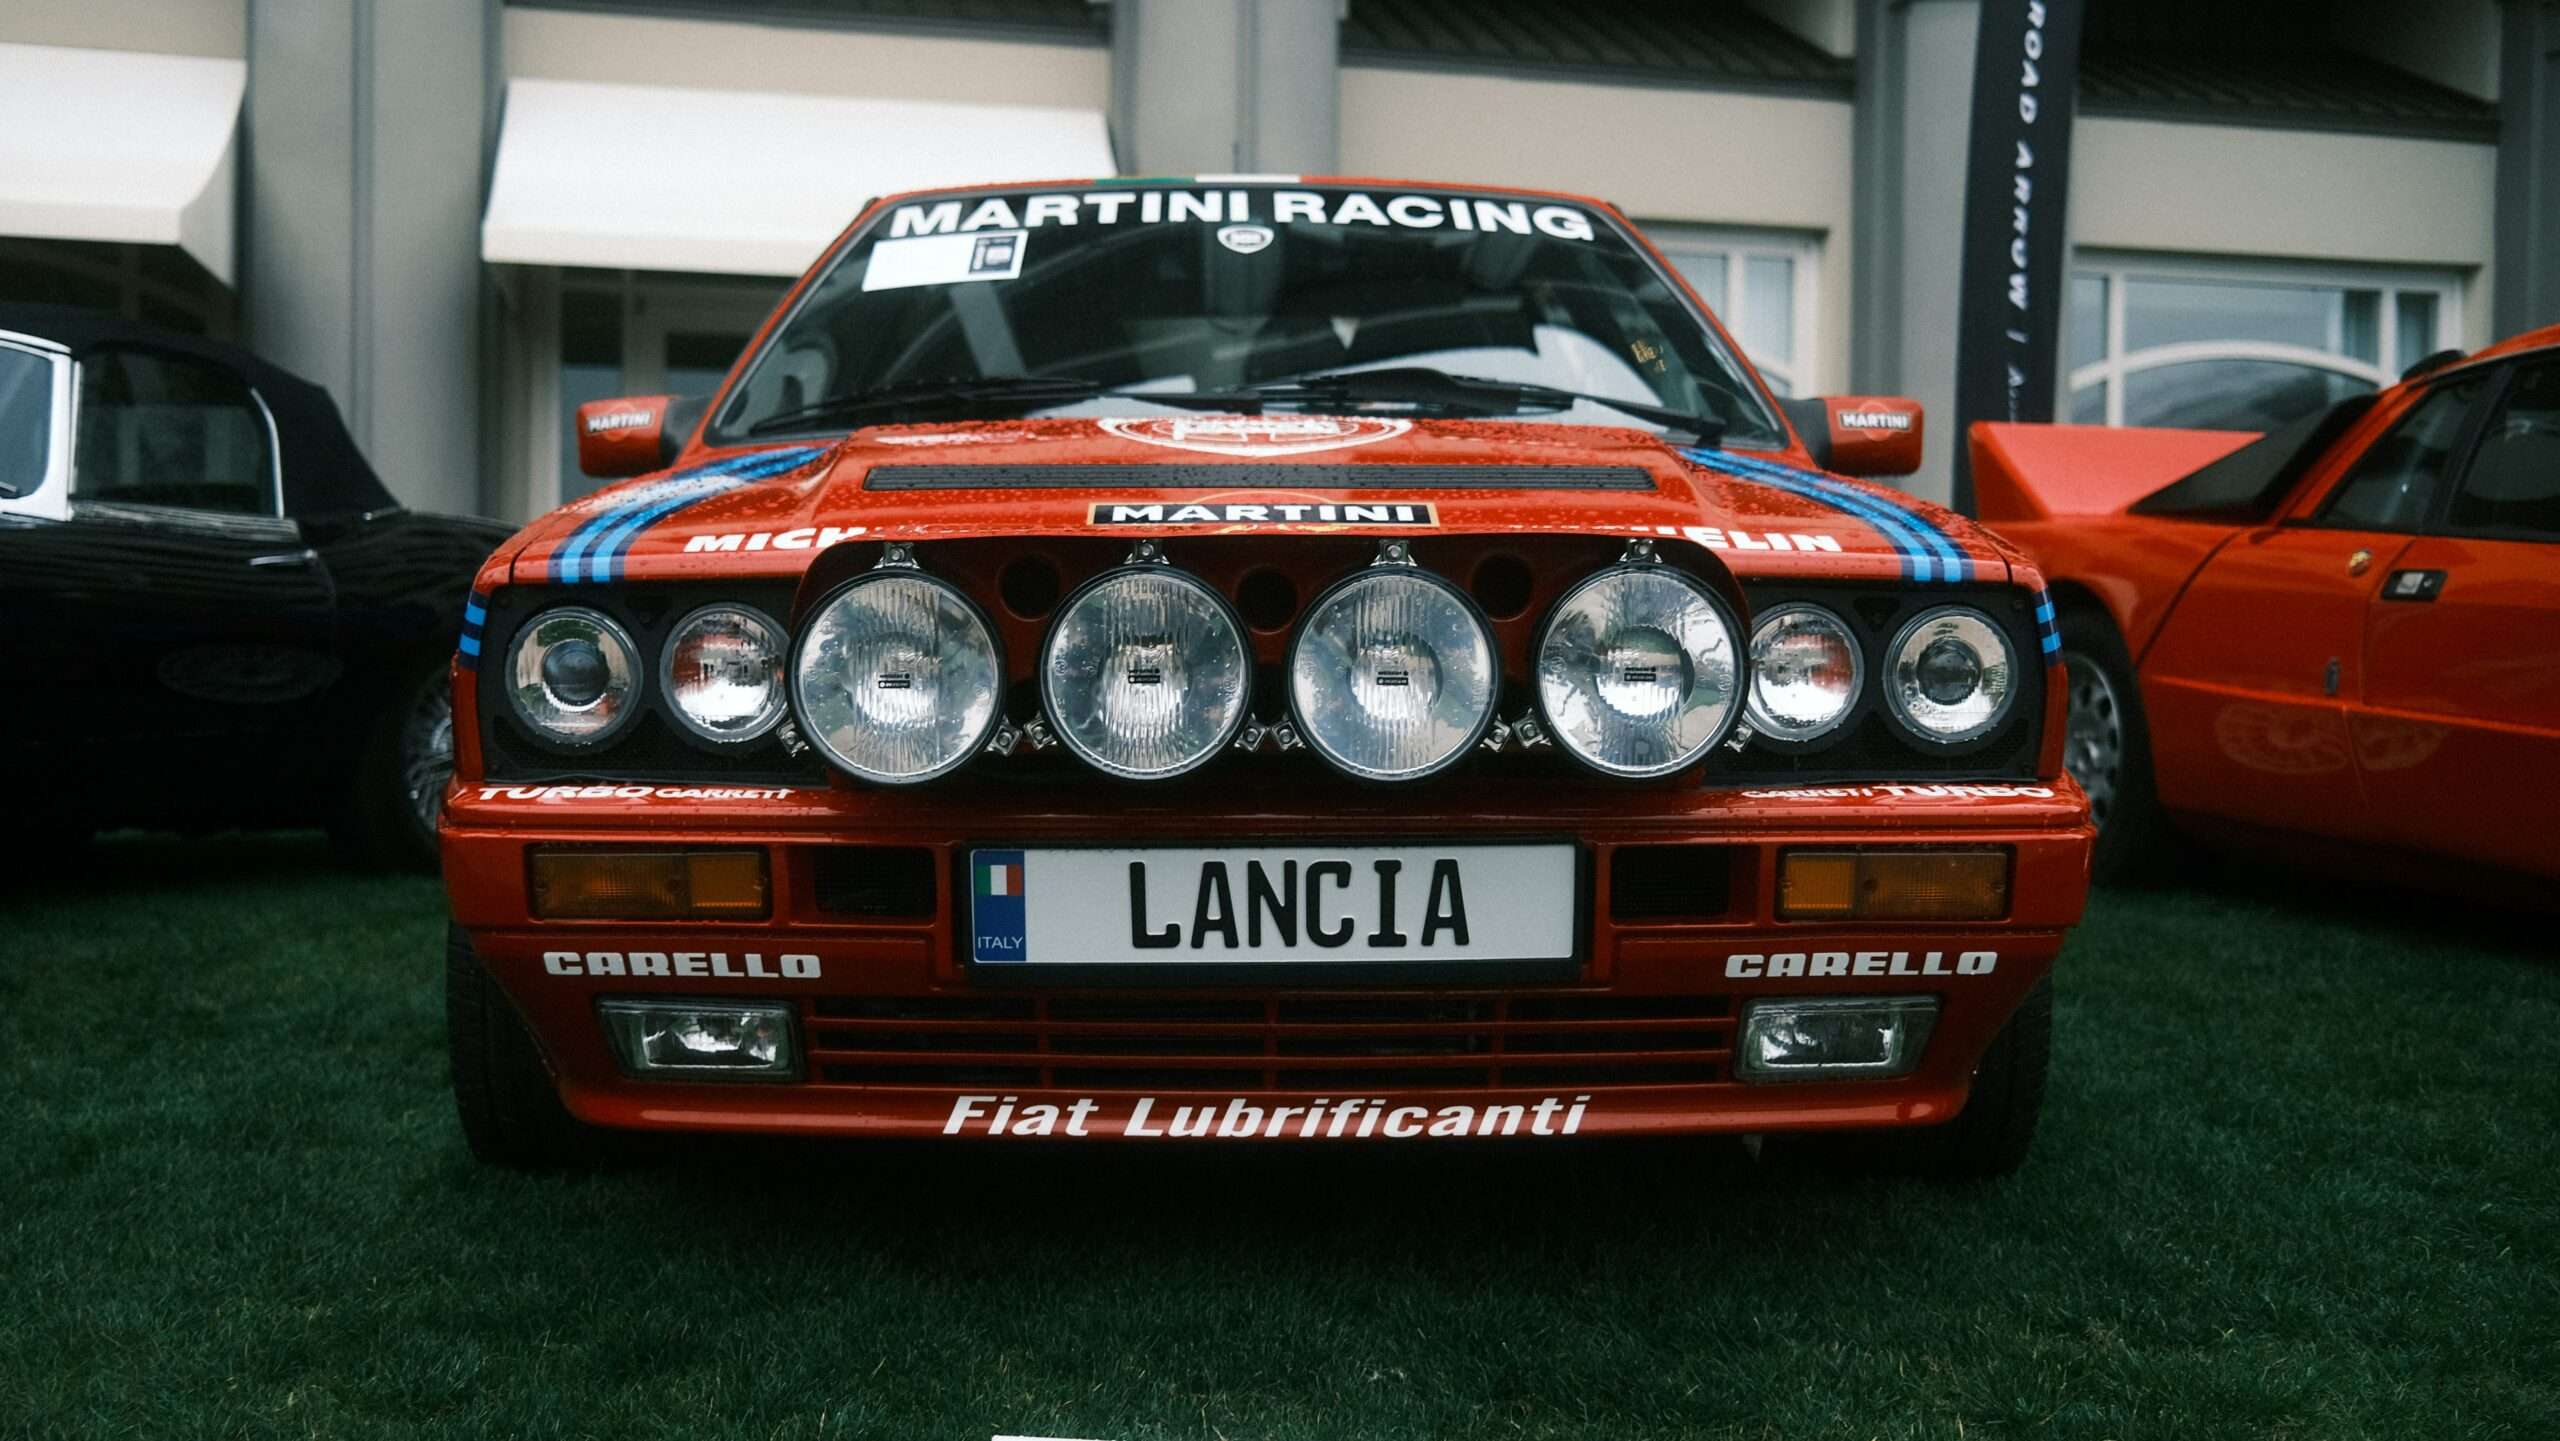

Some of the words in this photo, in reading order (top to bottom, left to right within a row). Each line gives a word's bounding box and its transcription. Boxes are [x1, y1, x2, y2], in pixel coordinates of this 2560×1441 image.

[890, 190, 1249, 237] MARTINI
[1273, 191, 1595, 241] RACING
[2008, 140, 2033, 311] ARROW
[587, 411, 651, 432] MARTINI
[1842, 414, 1909, 429] MARTINI
[1112, 505, 1414, 522] MARTINI
[479, 786, 655, 800] TURBO
[655, 788, 795, 799] GARRETT
[1741, 788, 1873, 798] GARRETT
[1872, 785, 2054, 798] TURBO
[1130, 859, 1470, 949] LANCIA
[977, 936, 1024, 949] ITALY
[543, 951, 822, 978] CARELLO
[1724, 951, 1999, 978] CARELLO
[942, 1095, 1100, 1136] Fiat
[1123, 1095, 1592, 1137] Lubrificanti
